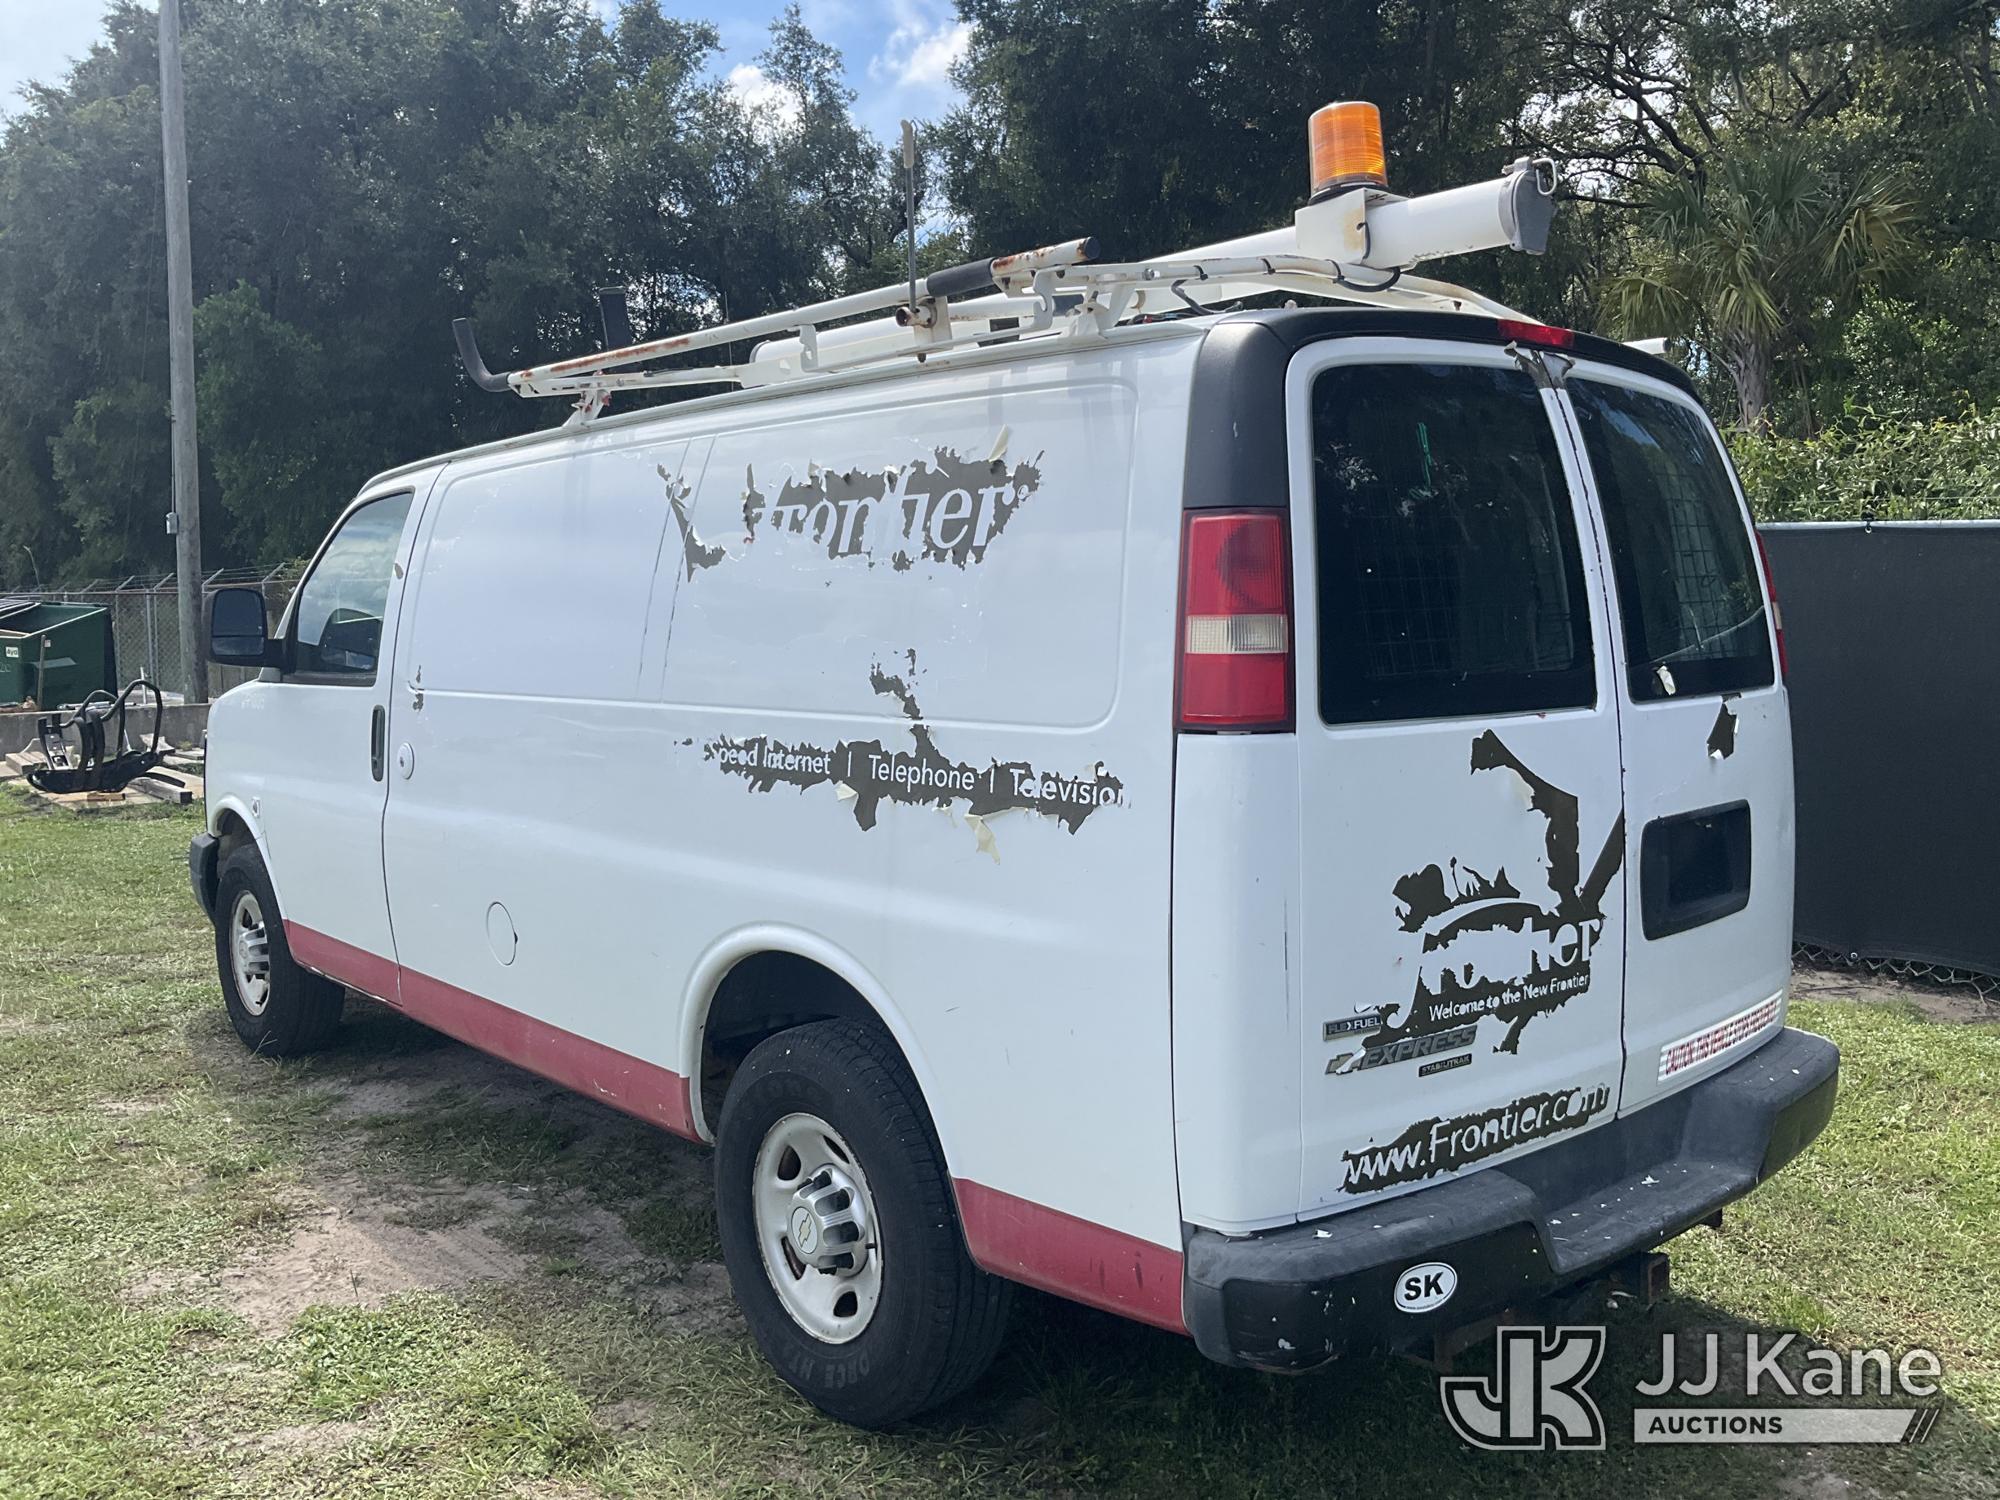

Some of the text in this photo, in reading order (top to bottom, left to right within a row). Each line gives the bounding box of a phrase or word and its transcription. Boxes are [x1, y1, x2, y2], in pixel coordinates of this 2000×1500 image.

[762, 745, 831, 775] Internet
[868, 754, 975, 793] Telephone
[1429, 972, 1589, 1022] Welcome to the New Frontier
[1362, 1027, 1477, 1070] EXPRESS
[1403, 1271, 1445, 1301] SK
